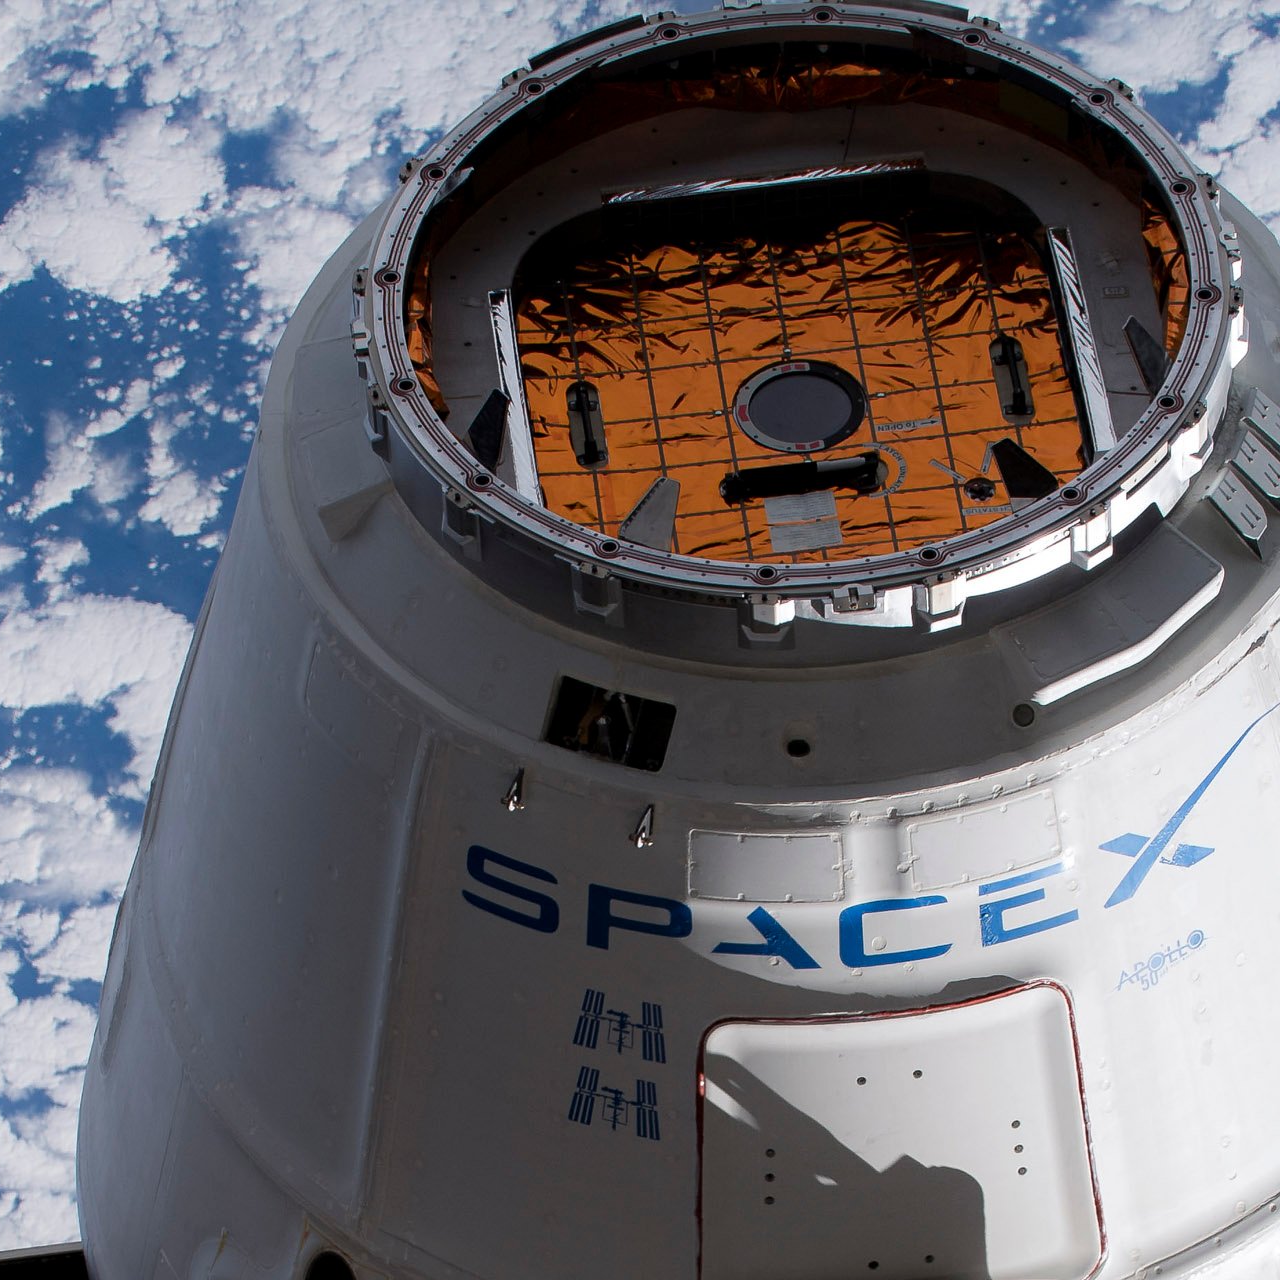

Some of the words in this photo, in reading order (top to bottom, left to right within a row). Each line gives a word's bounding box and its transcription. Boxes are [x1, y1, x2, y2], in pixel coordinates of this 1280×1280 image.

[878, 423, 903, 432] OPEN
[1116, 929, 1205, 991] APOLLO
[1140, 970, 1160, 991] 50
